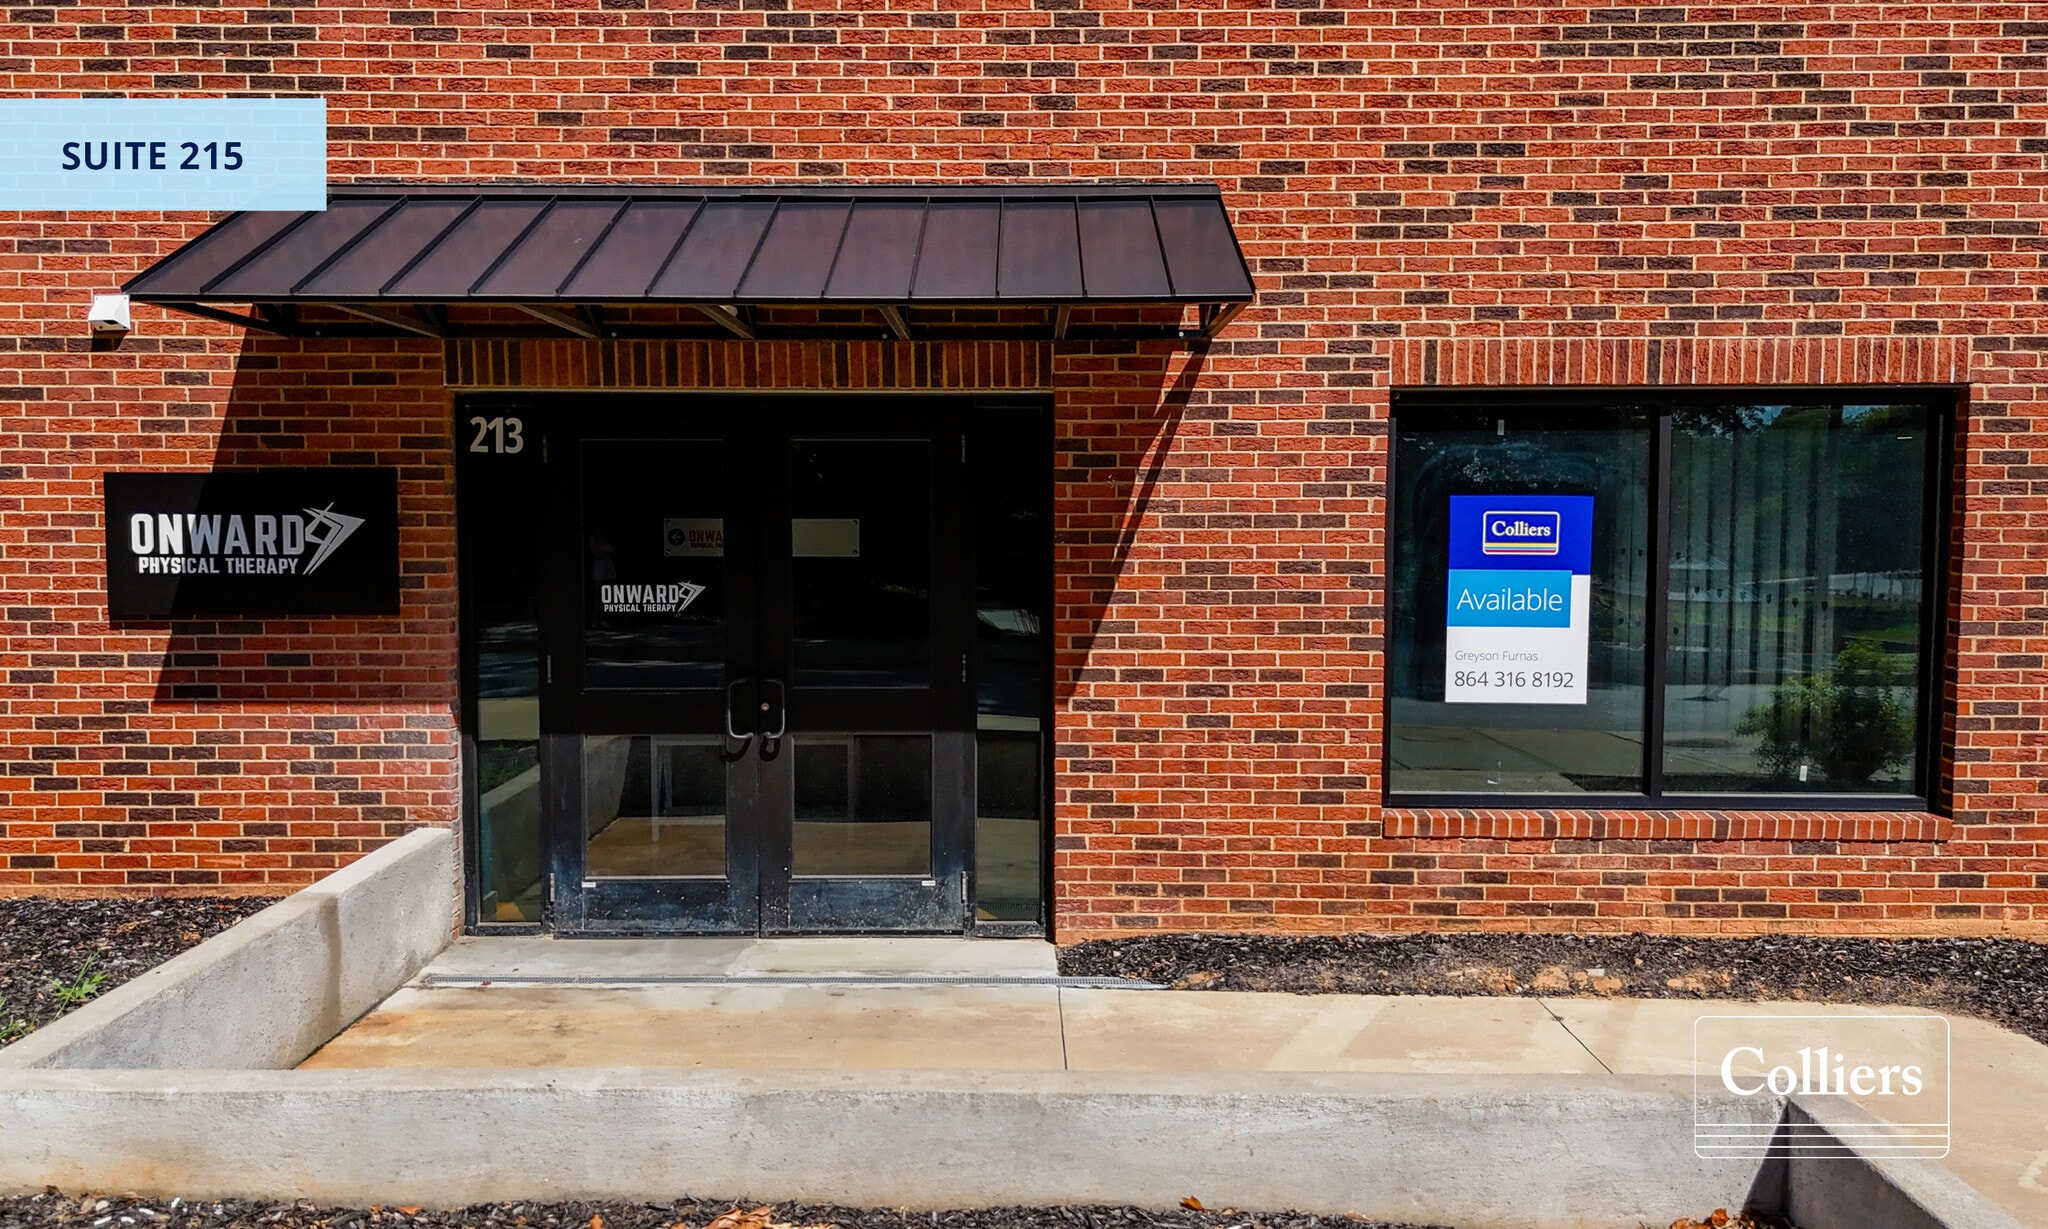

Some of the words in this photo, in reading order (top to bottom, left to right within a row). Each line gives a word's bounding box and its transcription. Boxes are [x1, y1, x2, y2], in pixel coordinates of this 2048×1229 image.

[470, 416, 524, 454] 213
[131, 513, 305, 555] ONWARD
[689, 530, 723, 542] ONWA
[1491, 520, 1551, 537] Colliers
[138, 557, 220, 575] PHYSICAL
[225, 557, 299, 575] THERAPY
[601, 584, 679, 604] ONWARD
[1456, 588, 1563, 611] Available
[604, 603, 641, 612] PHYSICAL
[643, 603, 676, 612] THERAPY
[1454, 650, 1499, 664] Greyson
[1502, 650, 1538, 661] Furnas
[1454, 671, 1489, 687] 864
[1494, 671, 1526, 687] 316
[1531, 672, 1574, 688] 8192
